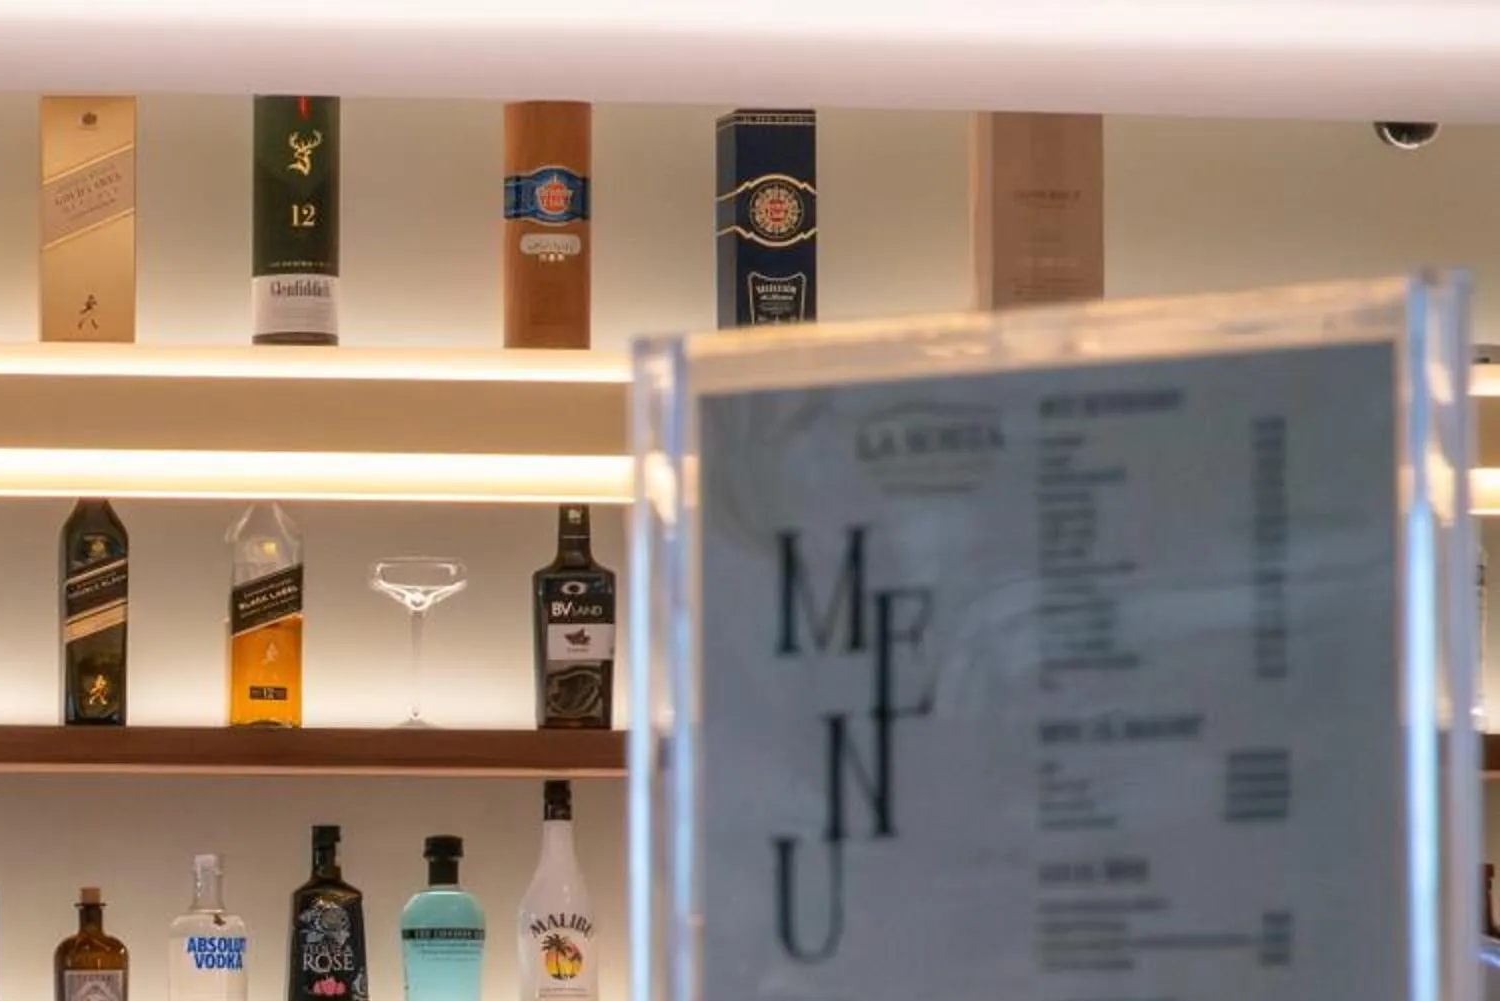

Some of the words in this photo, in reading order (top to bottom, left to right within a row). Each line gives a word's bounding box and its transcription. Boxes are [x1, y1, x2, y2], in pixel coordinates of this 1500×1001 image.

[290, 203, 316, 227] 12
[530, 911, 594, 938] MALIBU
[194, 952, 244, 970] VODKA
